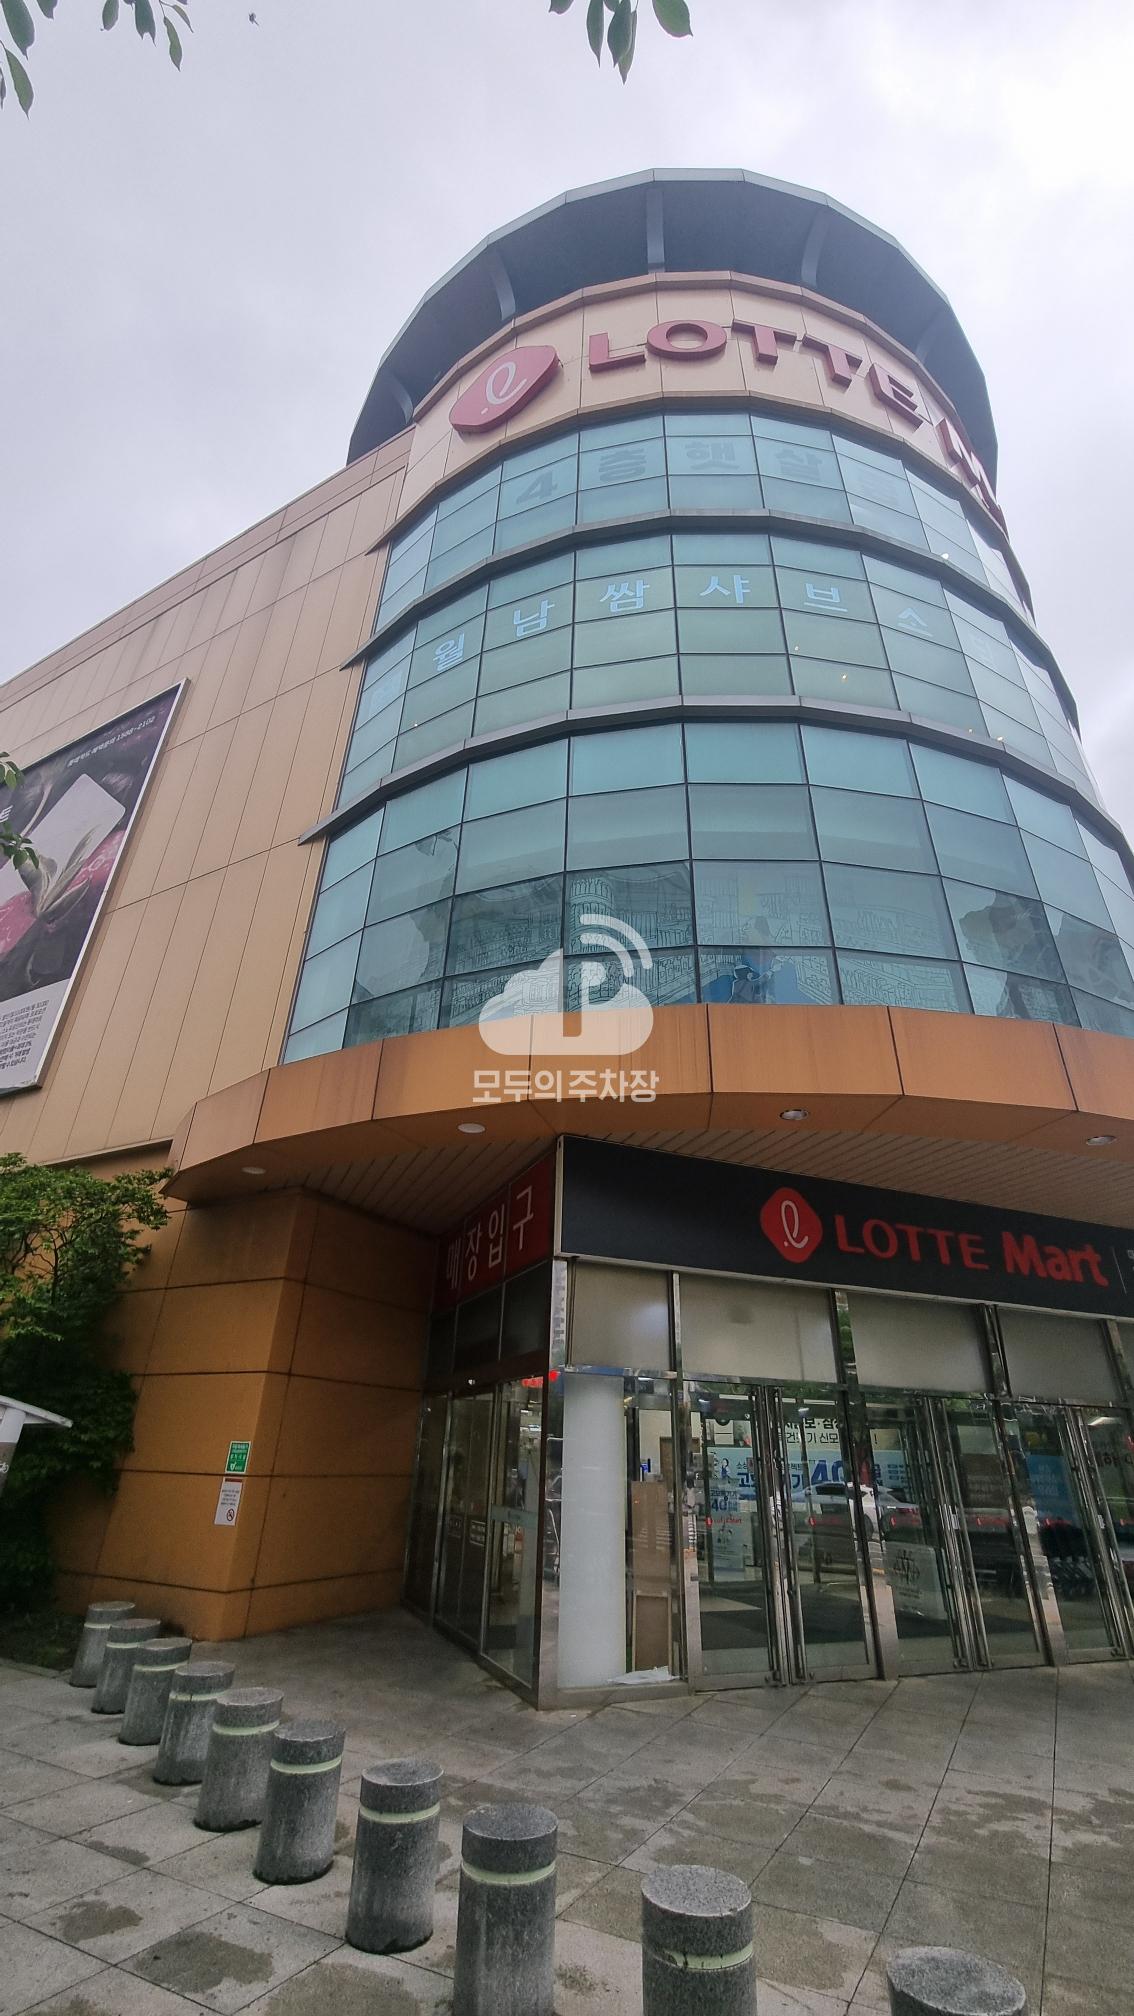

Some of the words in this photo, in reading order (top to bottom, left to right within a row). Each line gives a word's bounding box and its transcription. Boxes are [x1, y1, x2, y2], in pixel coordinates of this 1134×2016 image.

[589, 319, 924, 431] LOTTE
[833, 1214, 989, 1270] LOTTE
[1002, 1231, 1109, 1288] Mart
